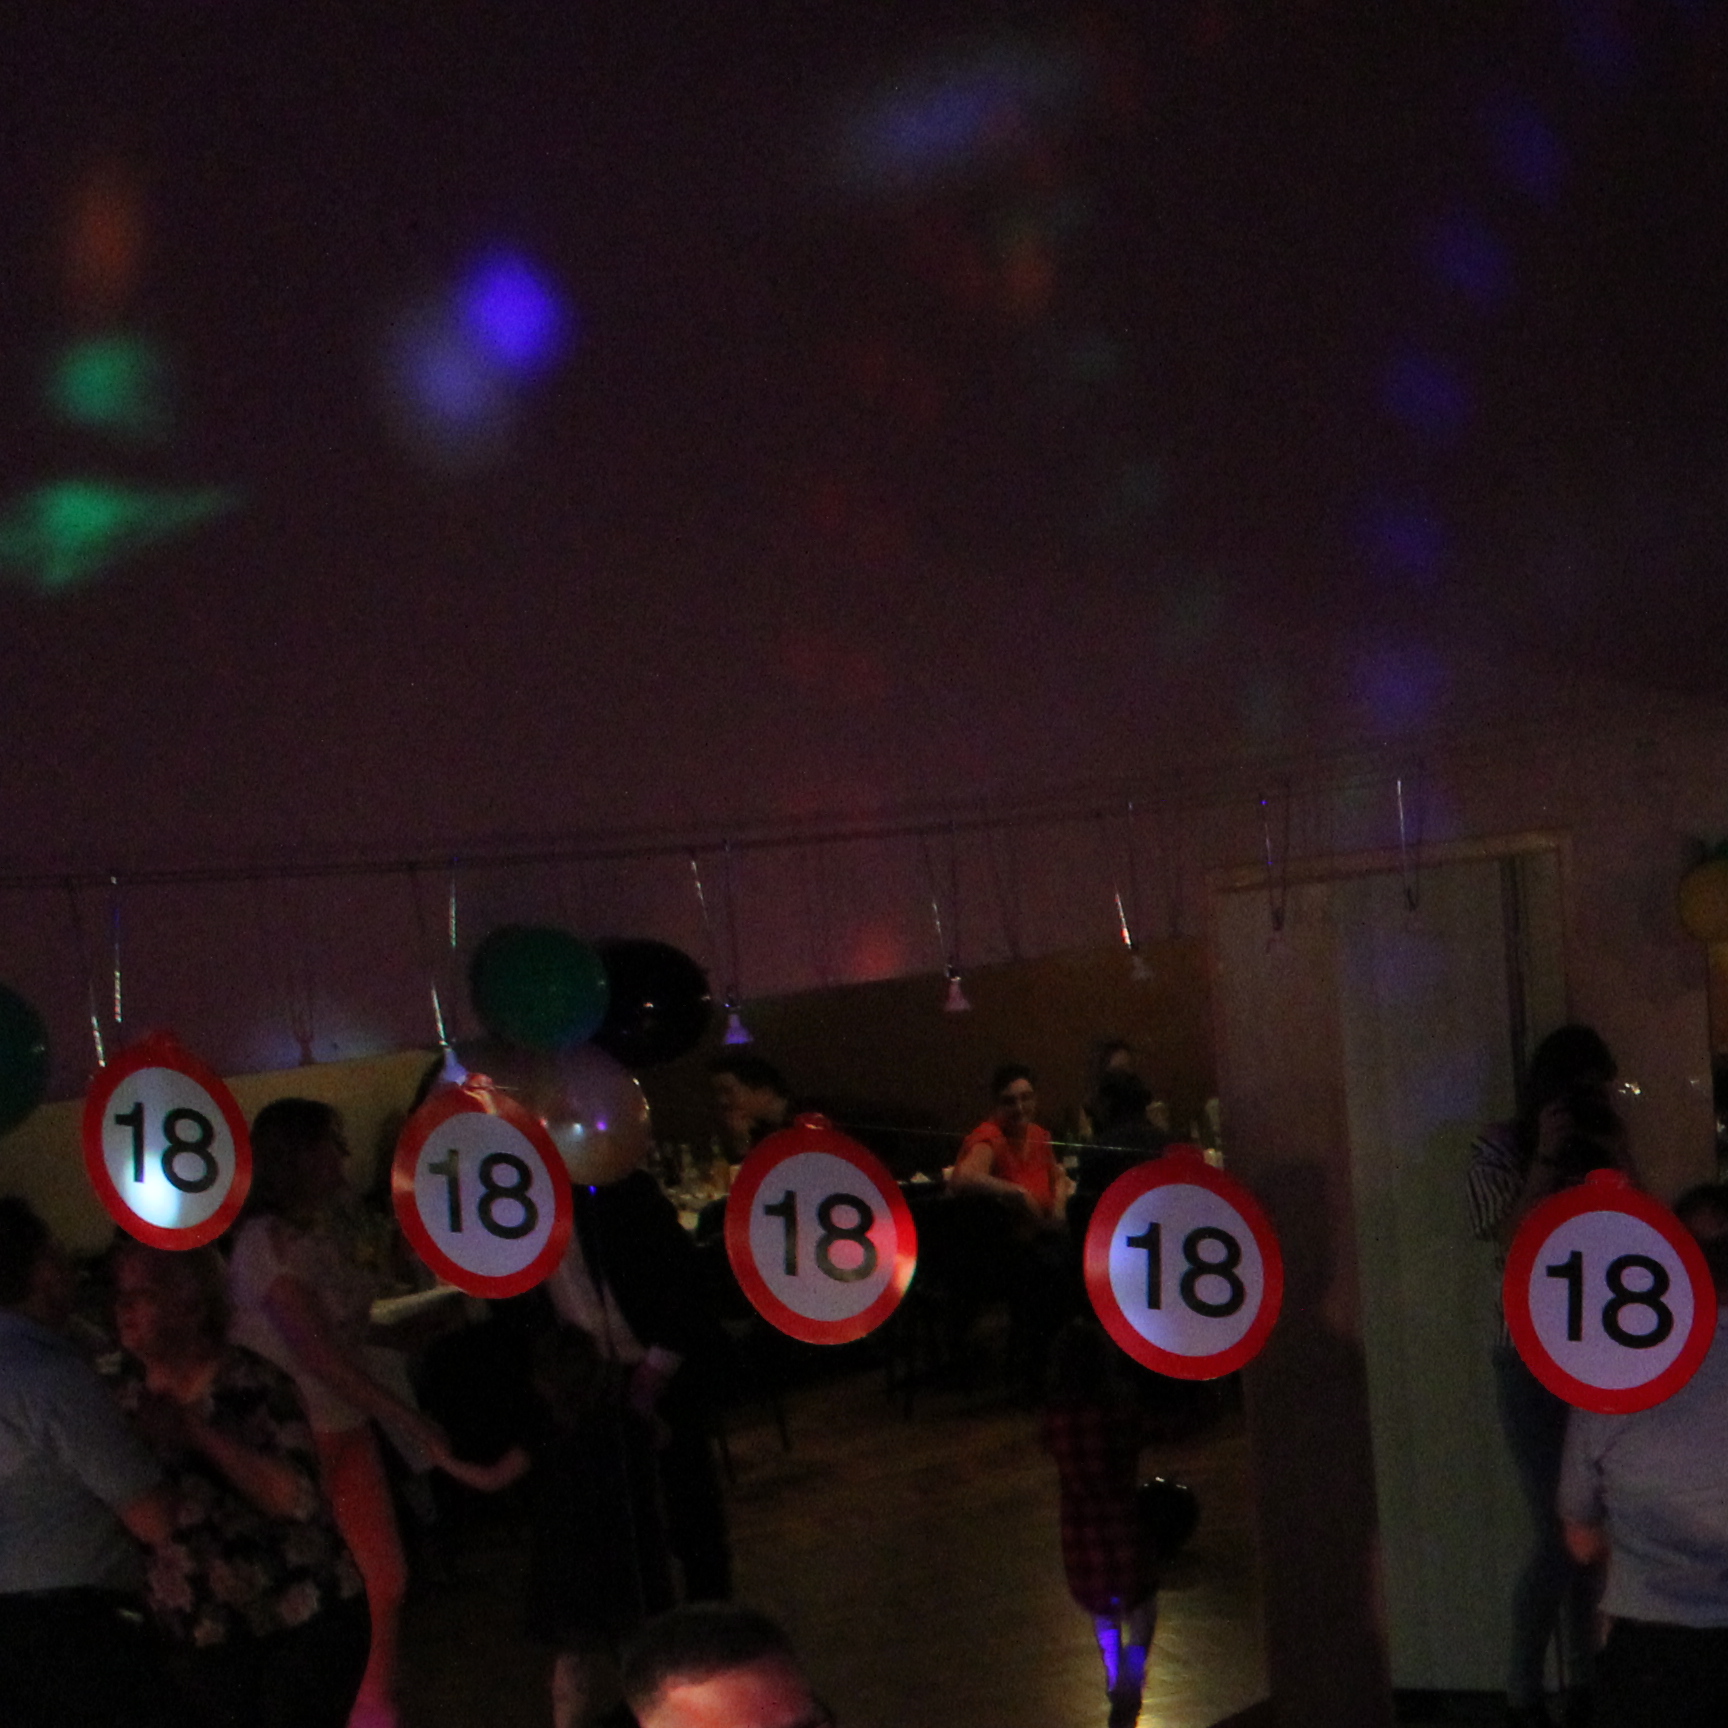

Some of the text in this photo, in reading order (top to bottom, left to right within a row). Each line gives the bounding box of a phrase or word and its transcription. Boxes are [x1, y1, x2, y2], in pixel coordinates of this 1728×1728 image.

[114, 1101, 218, 1193] 18
[430, 1150, 538, 1239] 18
[763, 1189, 877, 1282] 18
[1128, 1222, 1246, 1318] 18
[1546, 1251, 1673, 1349] 18
